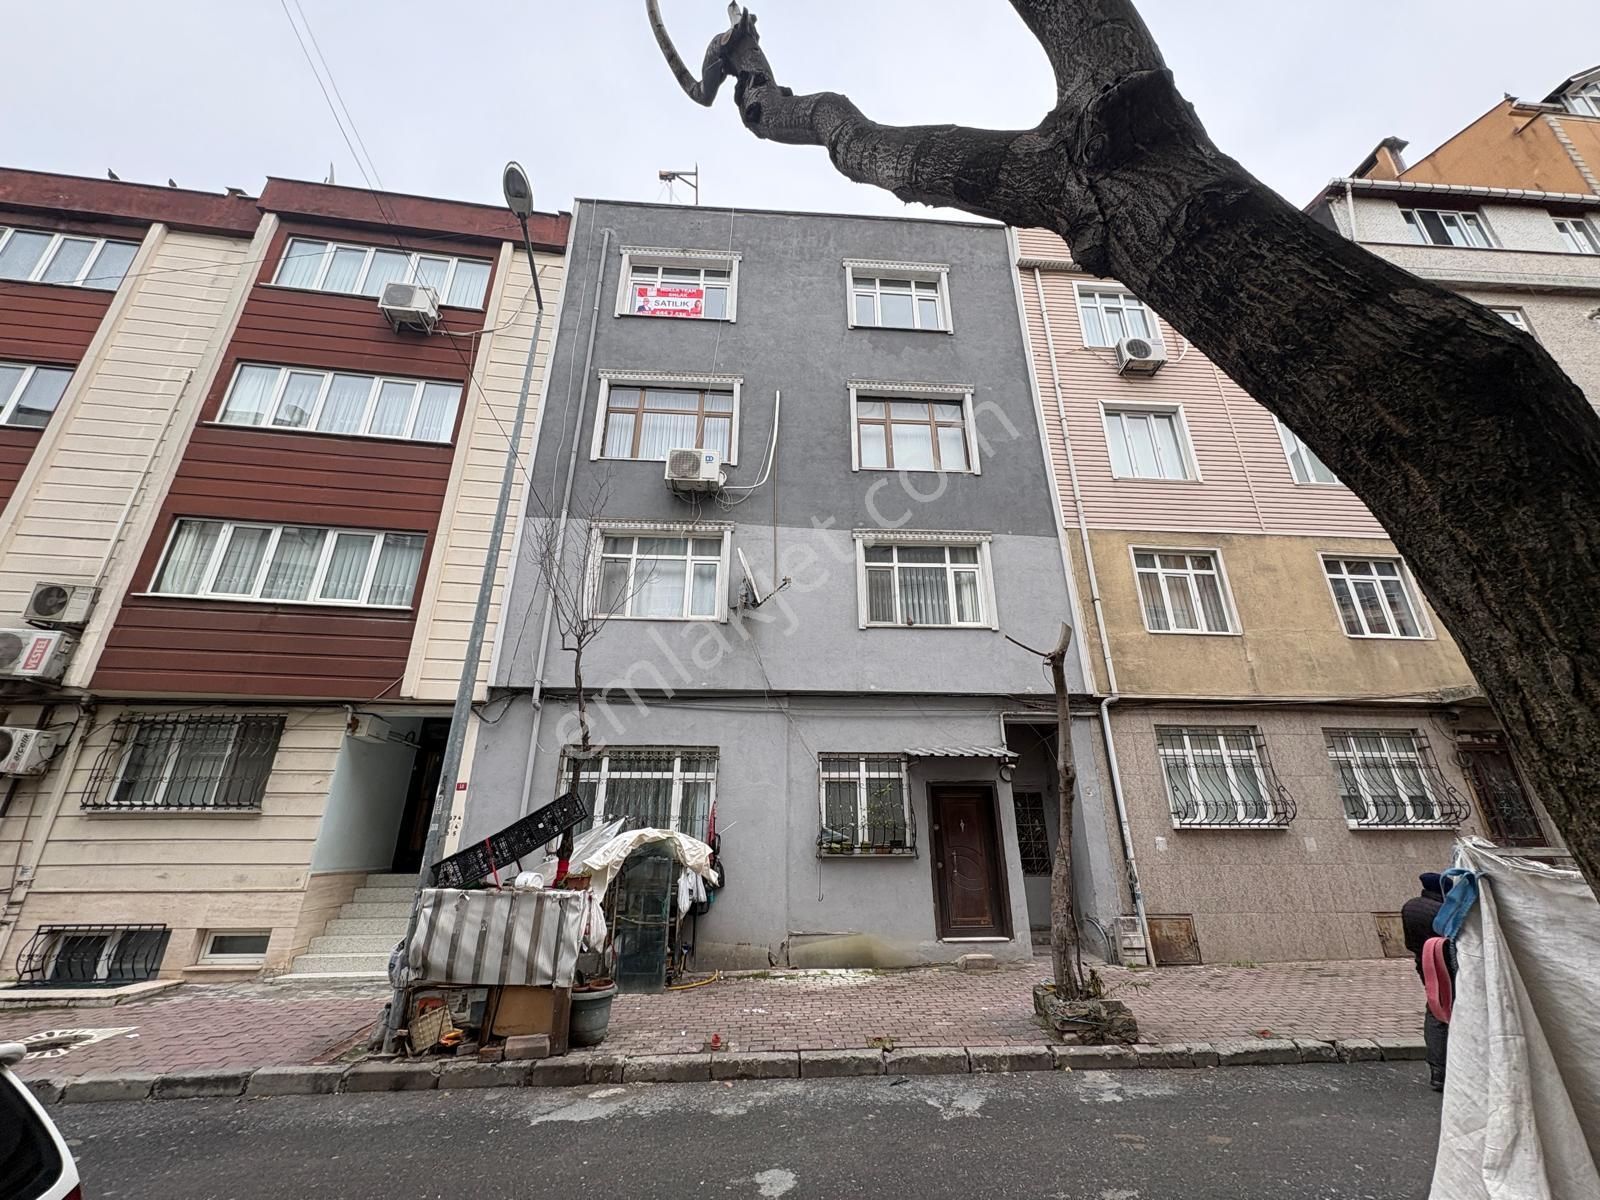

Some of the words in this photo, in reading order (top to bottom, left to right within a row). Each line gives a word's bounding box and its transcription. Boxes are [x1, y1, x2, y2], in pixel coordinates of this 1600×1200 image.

[654, 300, 689, 308] SATILIK
[26, 638, 48, 670] VESTEL
[13, 732, 32, 762] arçelik
